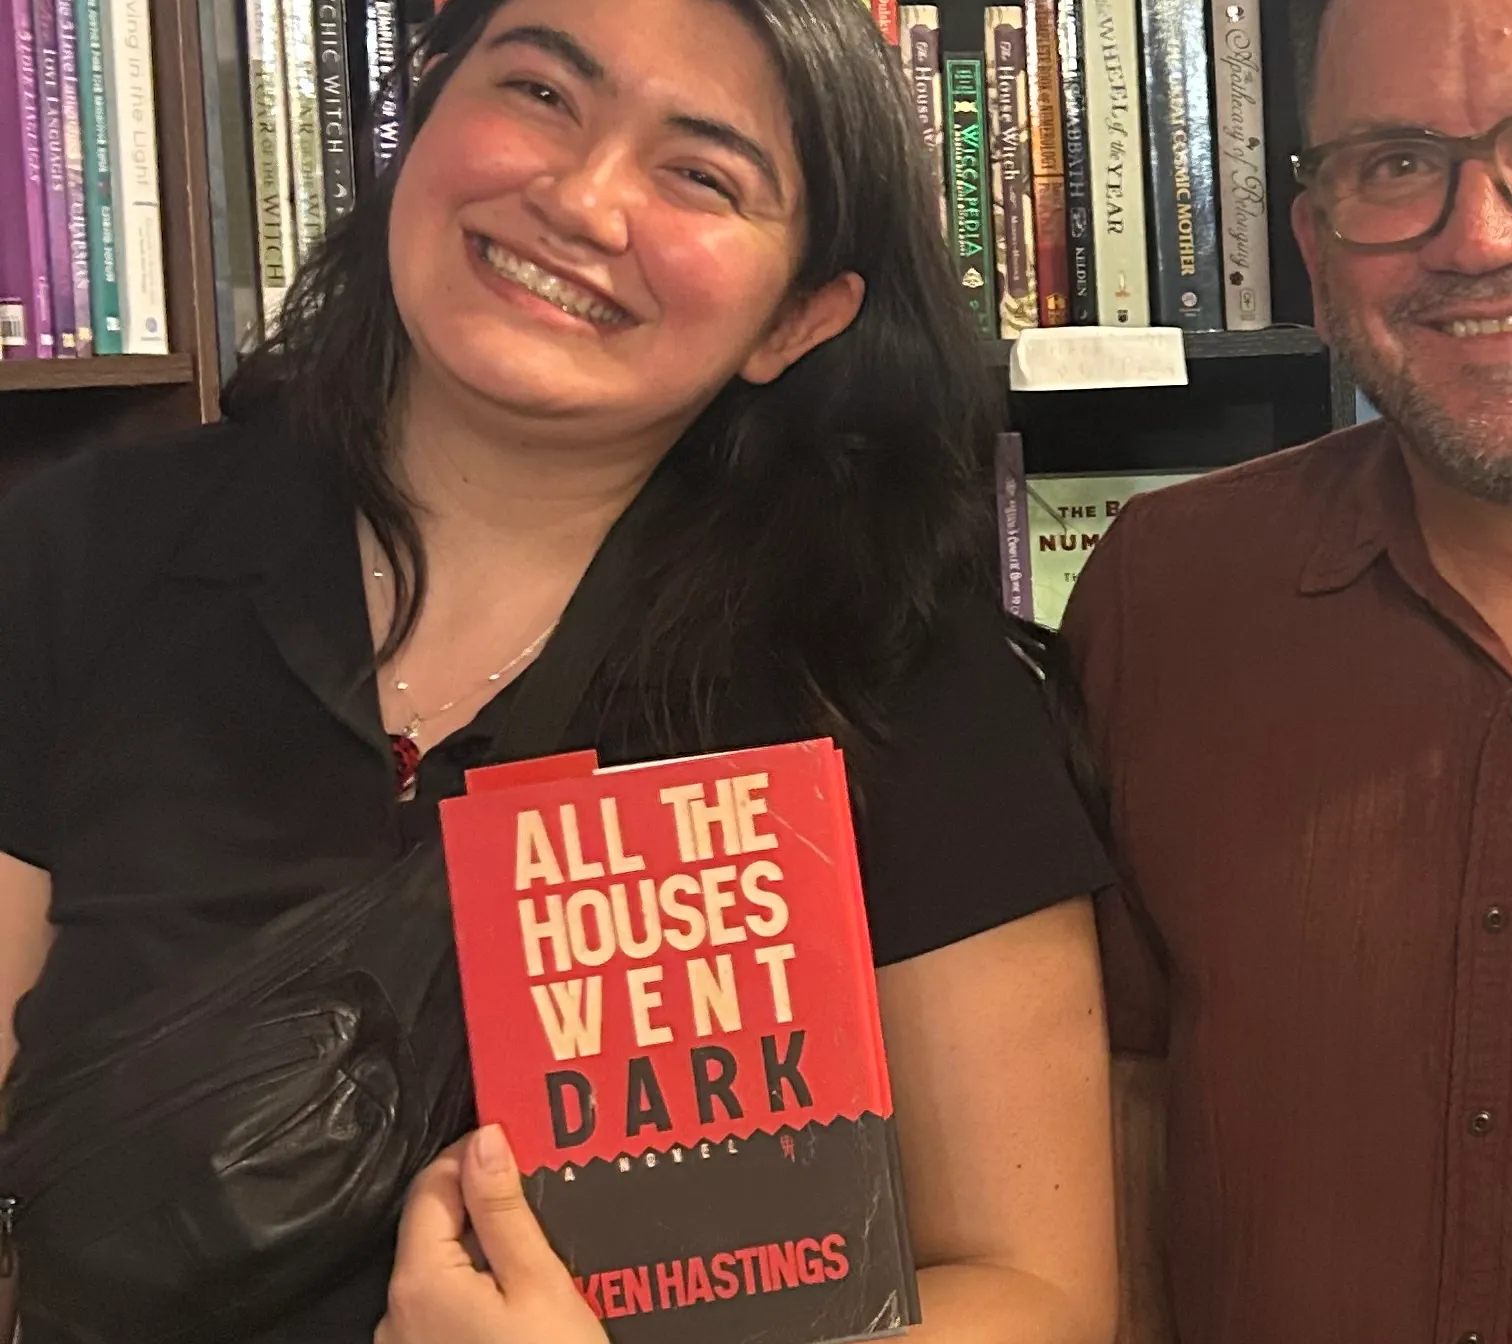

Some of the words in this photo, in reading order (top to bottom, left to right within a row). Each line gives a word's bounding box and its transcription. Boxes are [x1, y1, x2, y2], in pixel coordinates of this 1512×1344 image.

[129, 57, 141, 79] in
[914, 66, 933, 124] House
[998, 66, 1016, 123] House
[1099, 16, 1129, 119] WHEEL
[1221, 28, 1260, 143] Apothecary
[129, 86, 147, 121] the
[322, 74, 344, 153] WITCH
[1038, 104, 1056, 169] NUMEROLOGY
[1105, 117, 1128, 139] of
[133, 130, 151, 187] Light
[1001, 126, 1022, 180] Witch
[1108, 138, 1127, 160] the
[1171, 129, 1191, 200] COSMIC
[1223, 146, 1258, 173] of
[960, 123, 984, 257] WICCAPEDIA
[1105, 157, 1125, 235] YEAR
[1228, 170, 1265, 269] Belonging
[262, 194, 285, 281] WITCH
[1075, 247, 1088, 296] KELDEN
[1176, 203, 1195, 276] MOTHER
[1057, 506, 1097, 518] THE
[515, 797, 645, 891] ALL
[660, 772, 779, 863] THE
[517, 860, 789, 976] HOUSES
[531, 945, 796, 1061] WENT
[545, 1029, 814, 1149] DARK
[563, 1167, 576, 1182] A
[619, 1139, 738, 1173] NOVEL
[573, 1263, 652, 1320] KEN
[657, 1233, 849, 1310] HASTINGS
